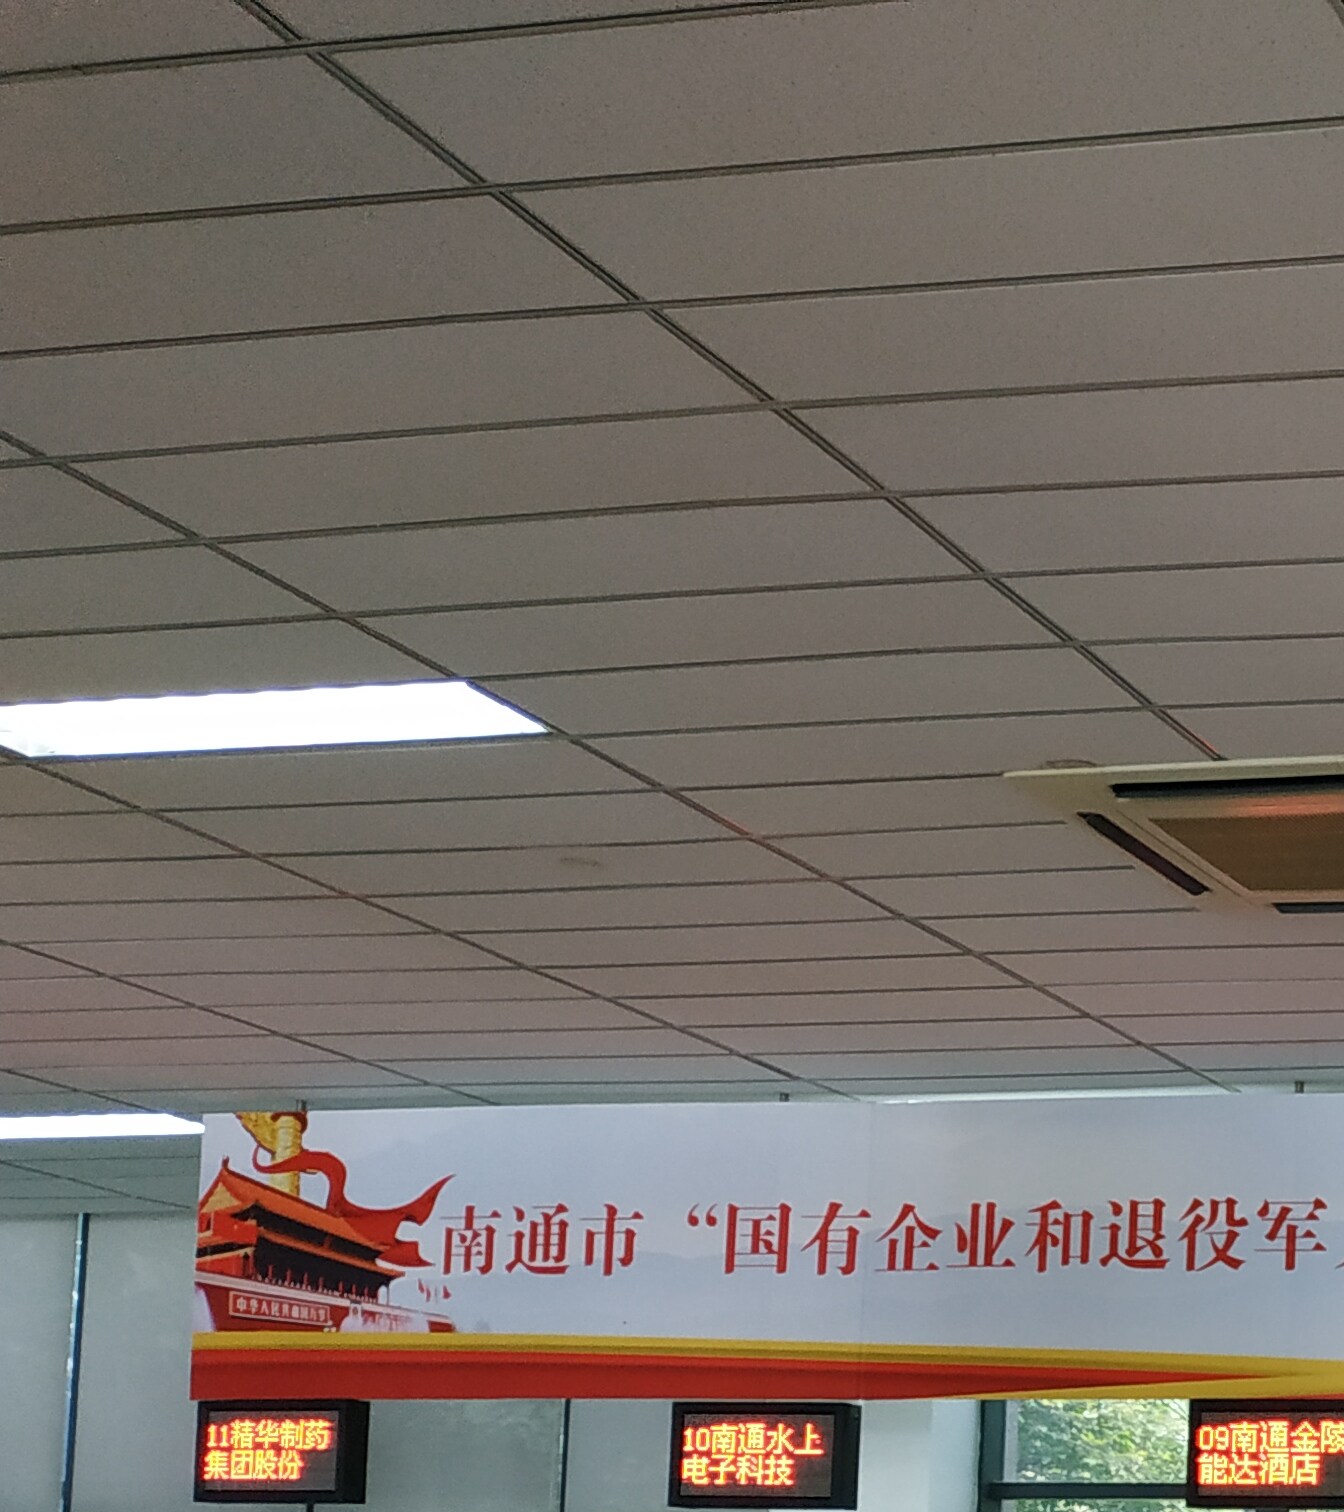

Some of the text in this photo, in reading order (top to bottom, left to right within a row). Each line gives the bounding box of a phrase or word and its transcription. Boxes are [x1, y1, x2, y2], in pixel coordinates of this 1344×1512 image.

[441, 1203, 645, 1277] 南通市
[206, 1418, 333, 1450] 11精华制药
[683, 1422, 825, 1455] 10南通水上
[203, 1449, 304, 1481] 集团股份
[681, 1454, 796, 1485] 电子科技
[1197, 1453, 1321, 1486] 能达酒店
